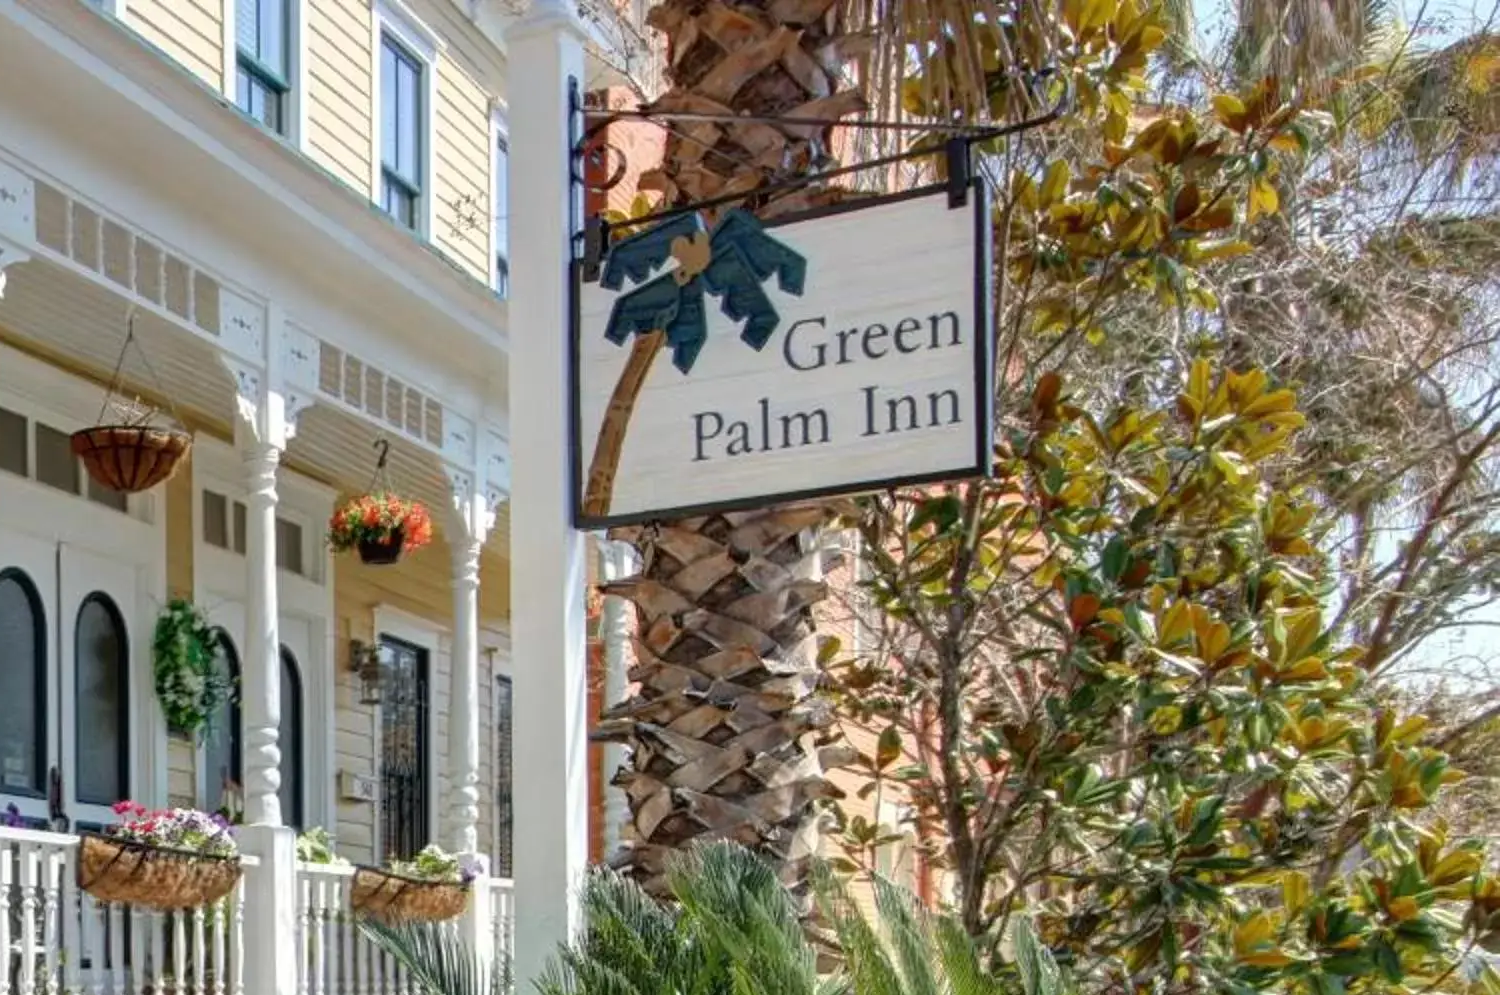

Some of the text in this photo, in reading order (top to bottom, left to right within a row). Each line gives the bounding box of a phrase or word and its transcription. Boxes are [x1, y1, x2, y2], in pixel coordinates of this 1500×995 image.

[782, 309, 964, 372] Green
[690, 384, 963, 463] Palm Inn
